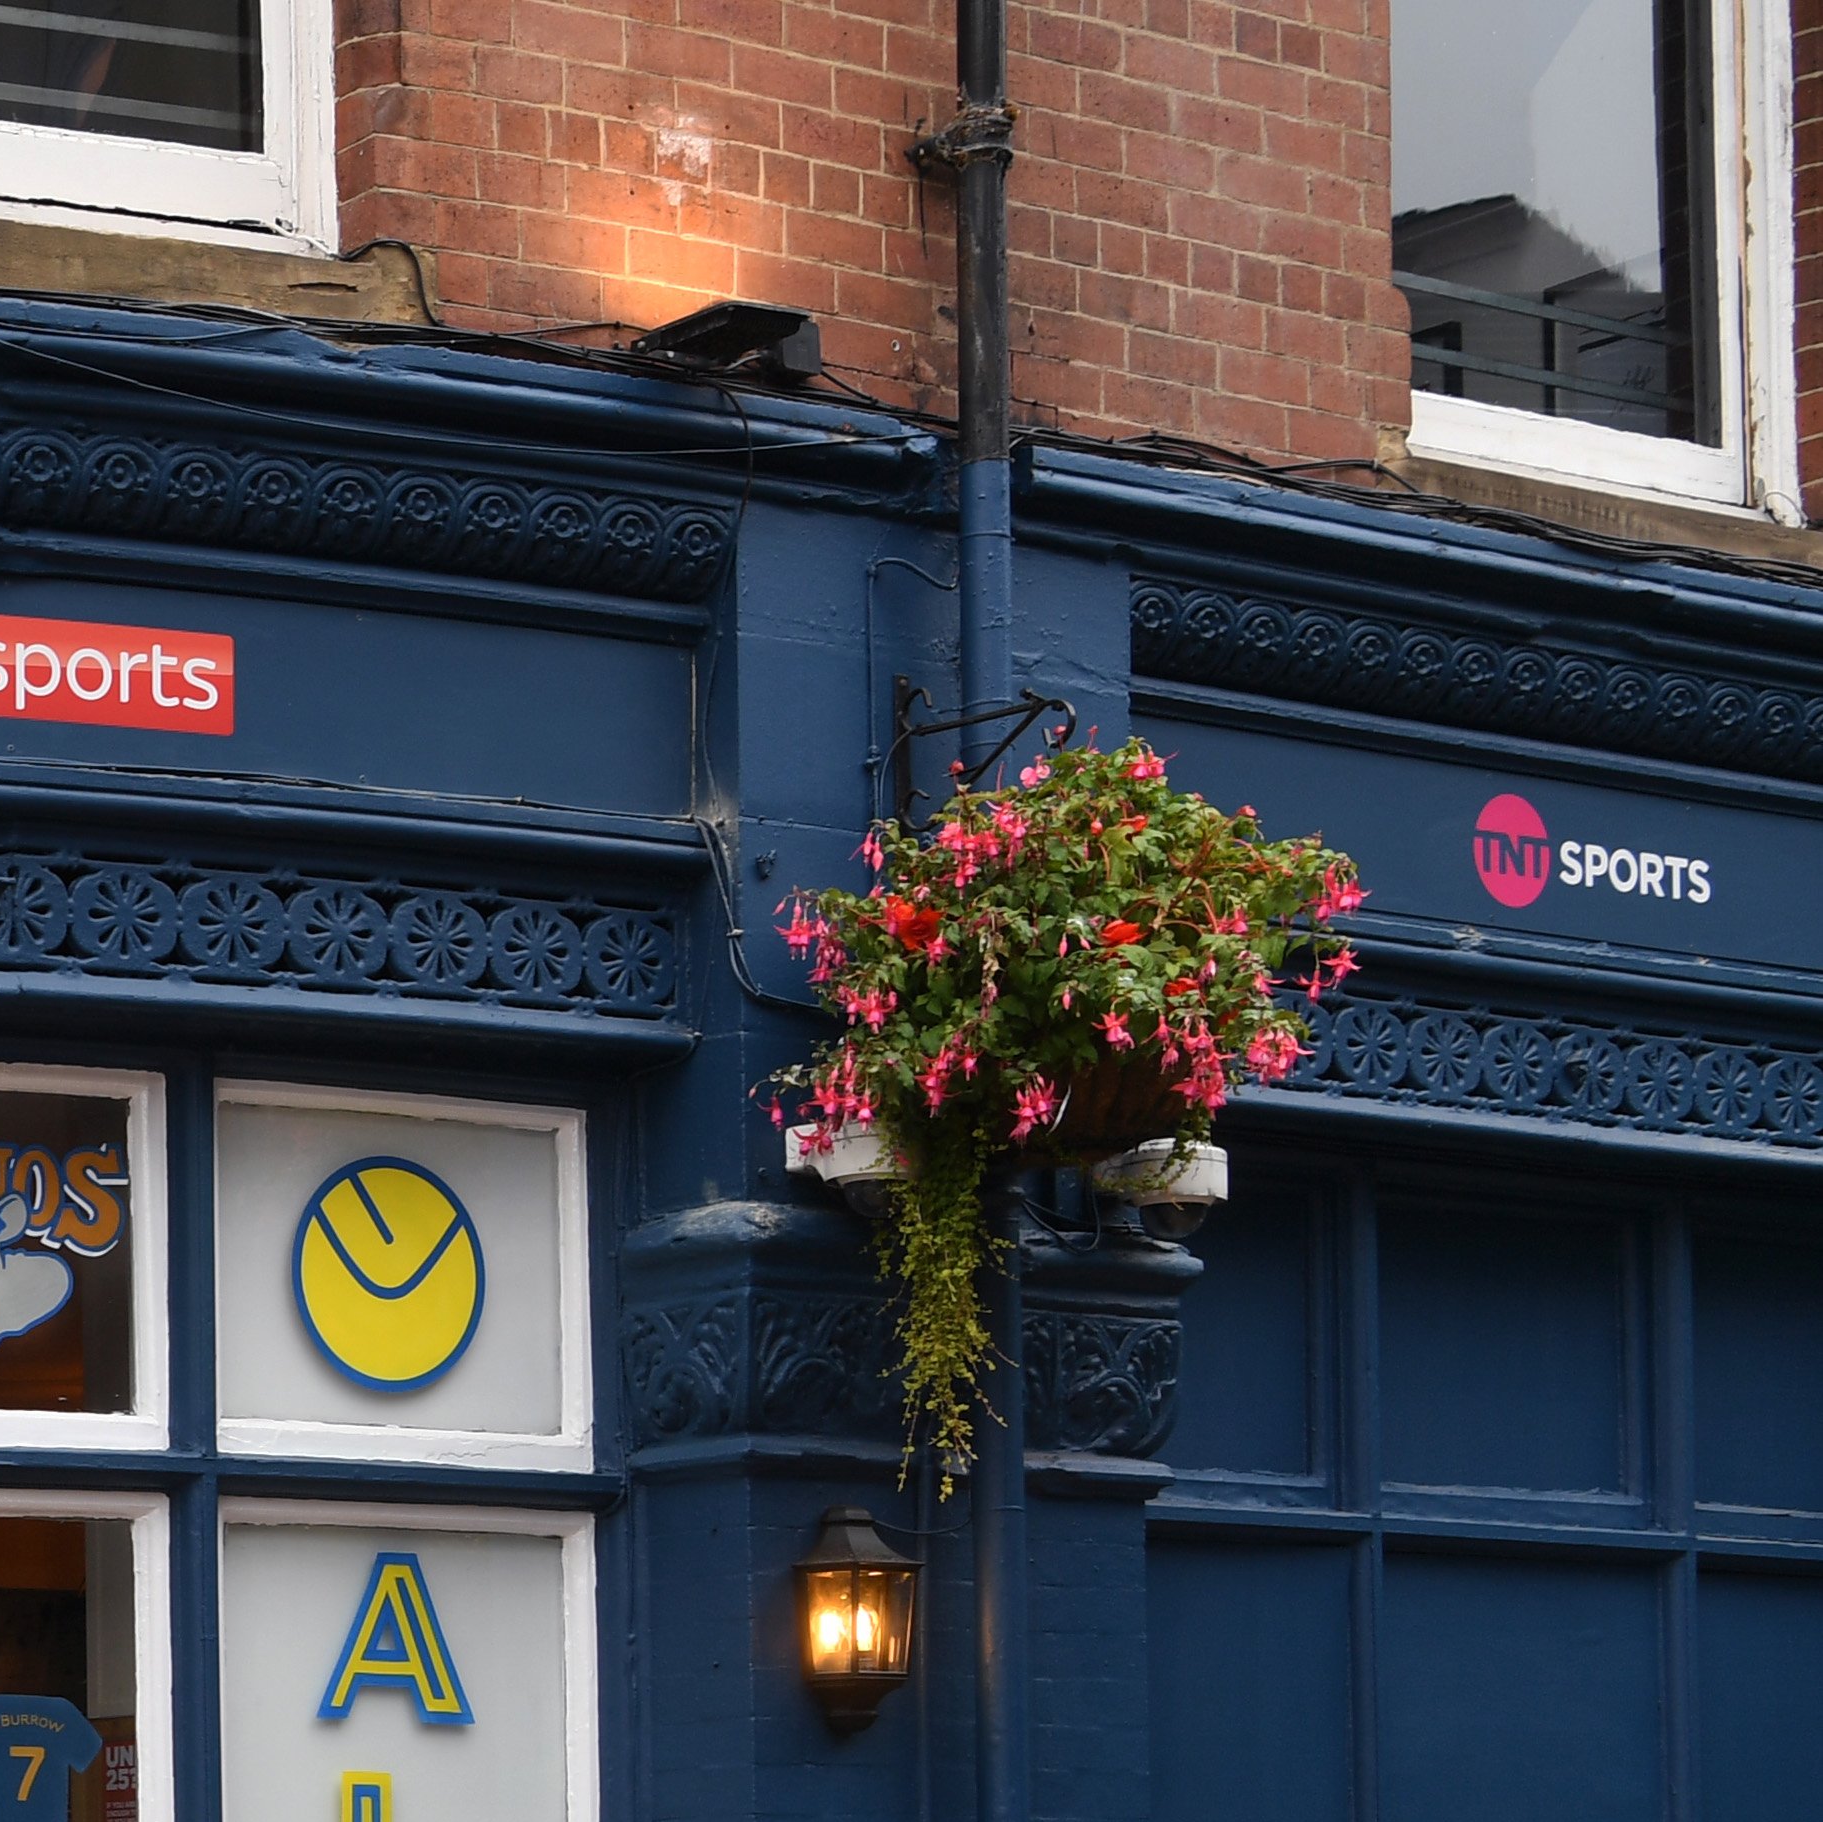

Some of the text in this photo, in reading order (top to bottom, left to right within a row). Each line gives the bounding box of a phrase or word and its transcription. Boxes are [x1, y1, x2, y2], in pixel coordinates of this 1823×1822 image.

[1474, 830, 1711, 903] TNT SPORTS
[9, 1746, 46, 1802] 7
